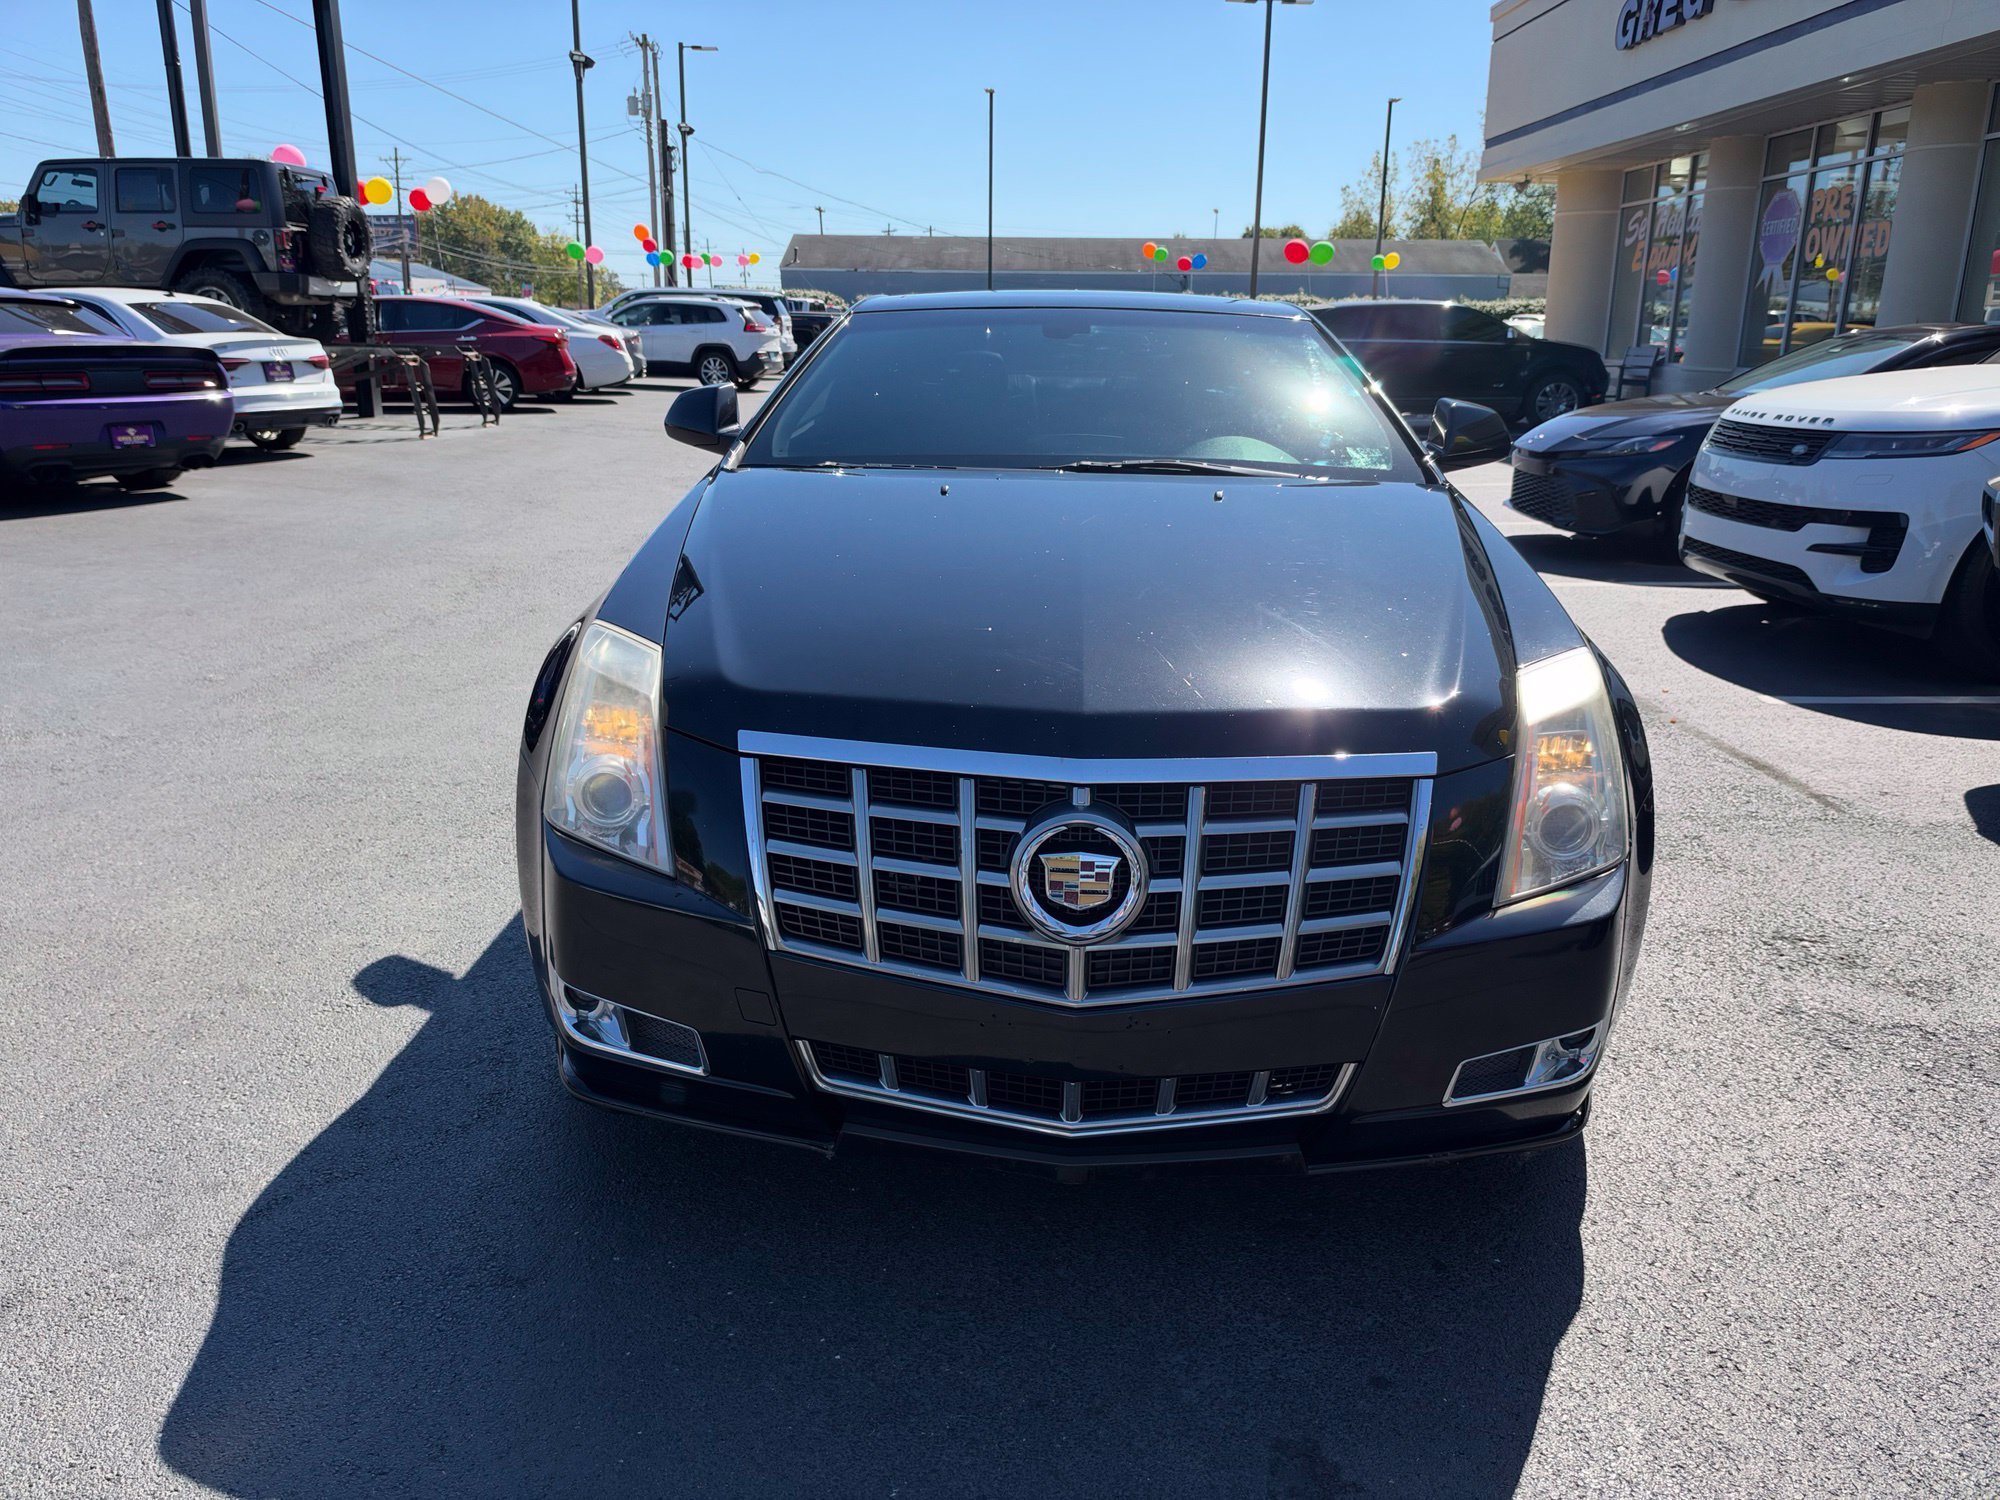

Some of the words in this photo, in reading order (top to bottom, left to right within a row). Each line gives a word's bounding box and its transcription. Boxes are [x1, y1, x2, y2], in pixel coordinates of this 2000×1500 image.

[1624, 209, 1648, 248] Se
[1761, 218, 1797, 237] CERTIFIED
[1804, 220, 1892, 263] OWNED
[1730, 408, 1767, 419] RANGE
[1773, 414, 1835, 425] ROVER
